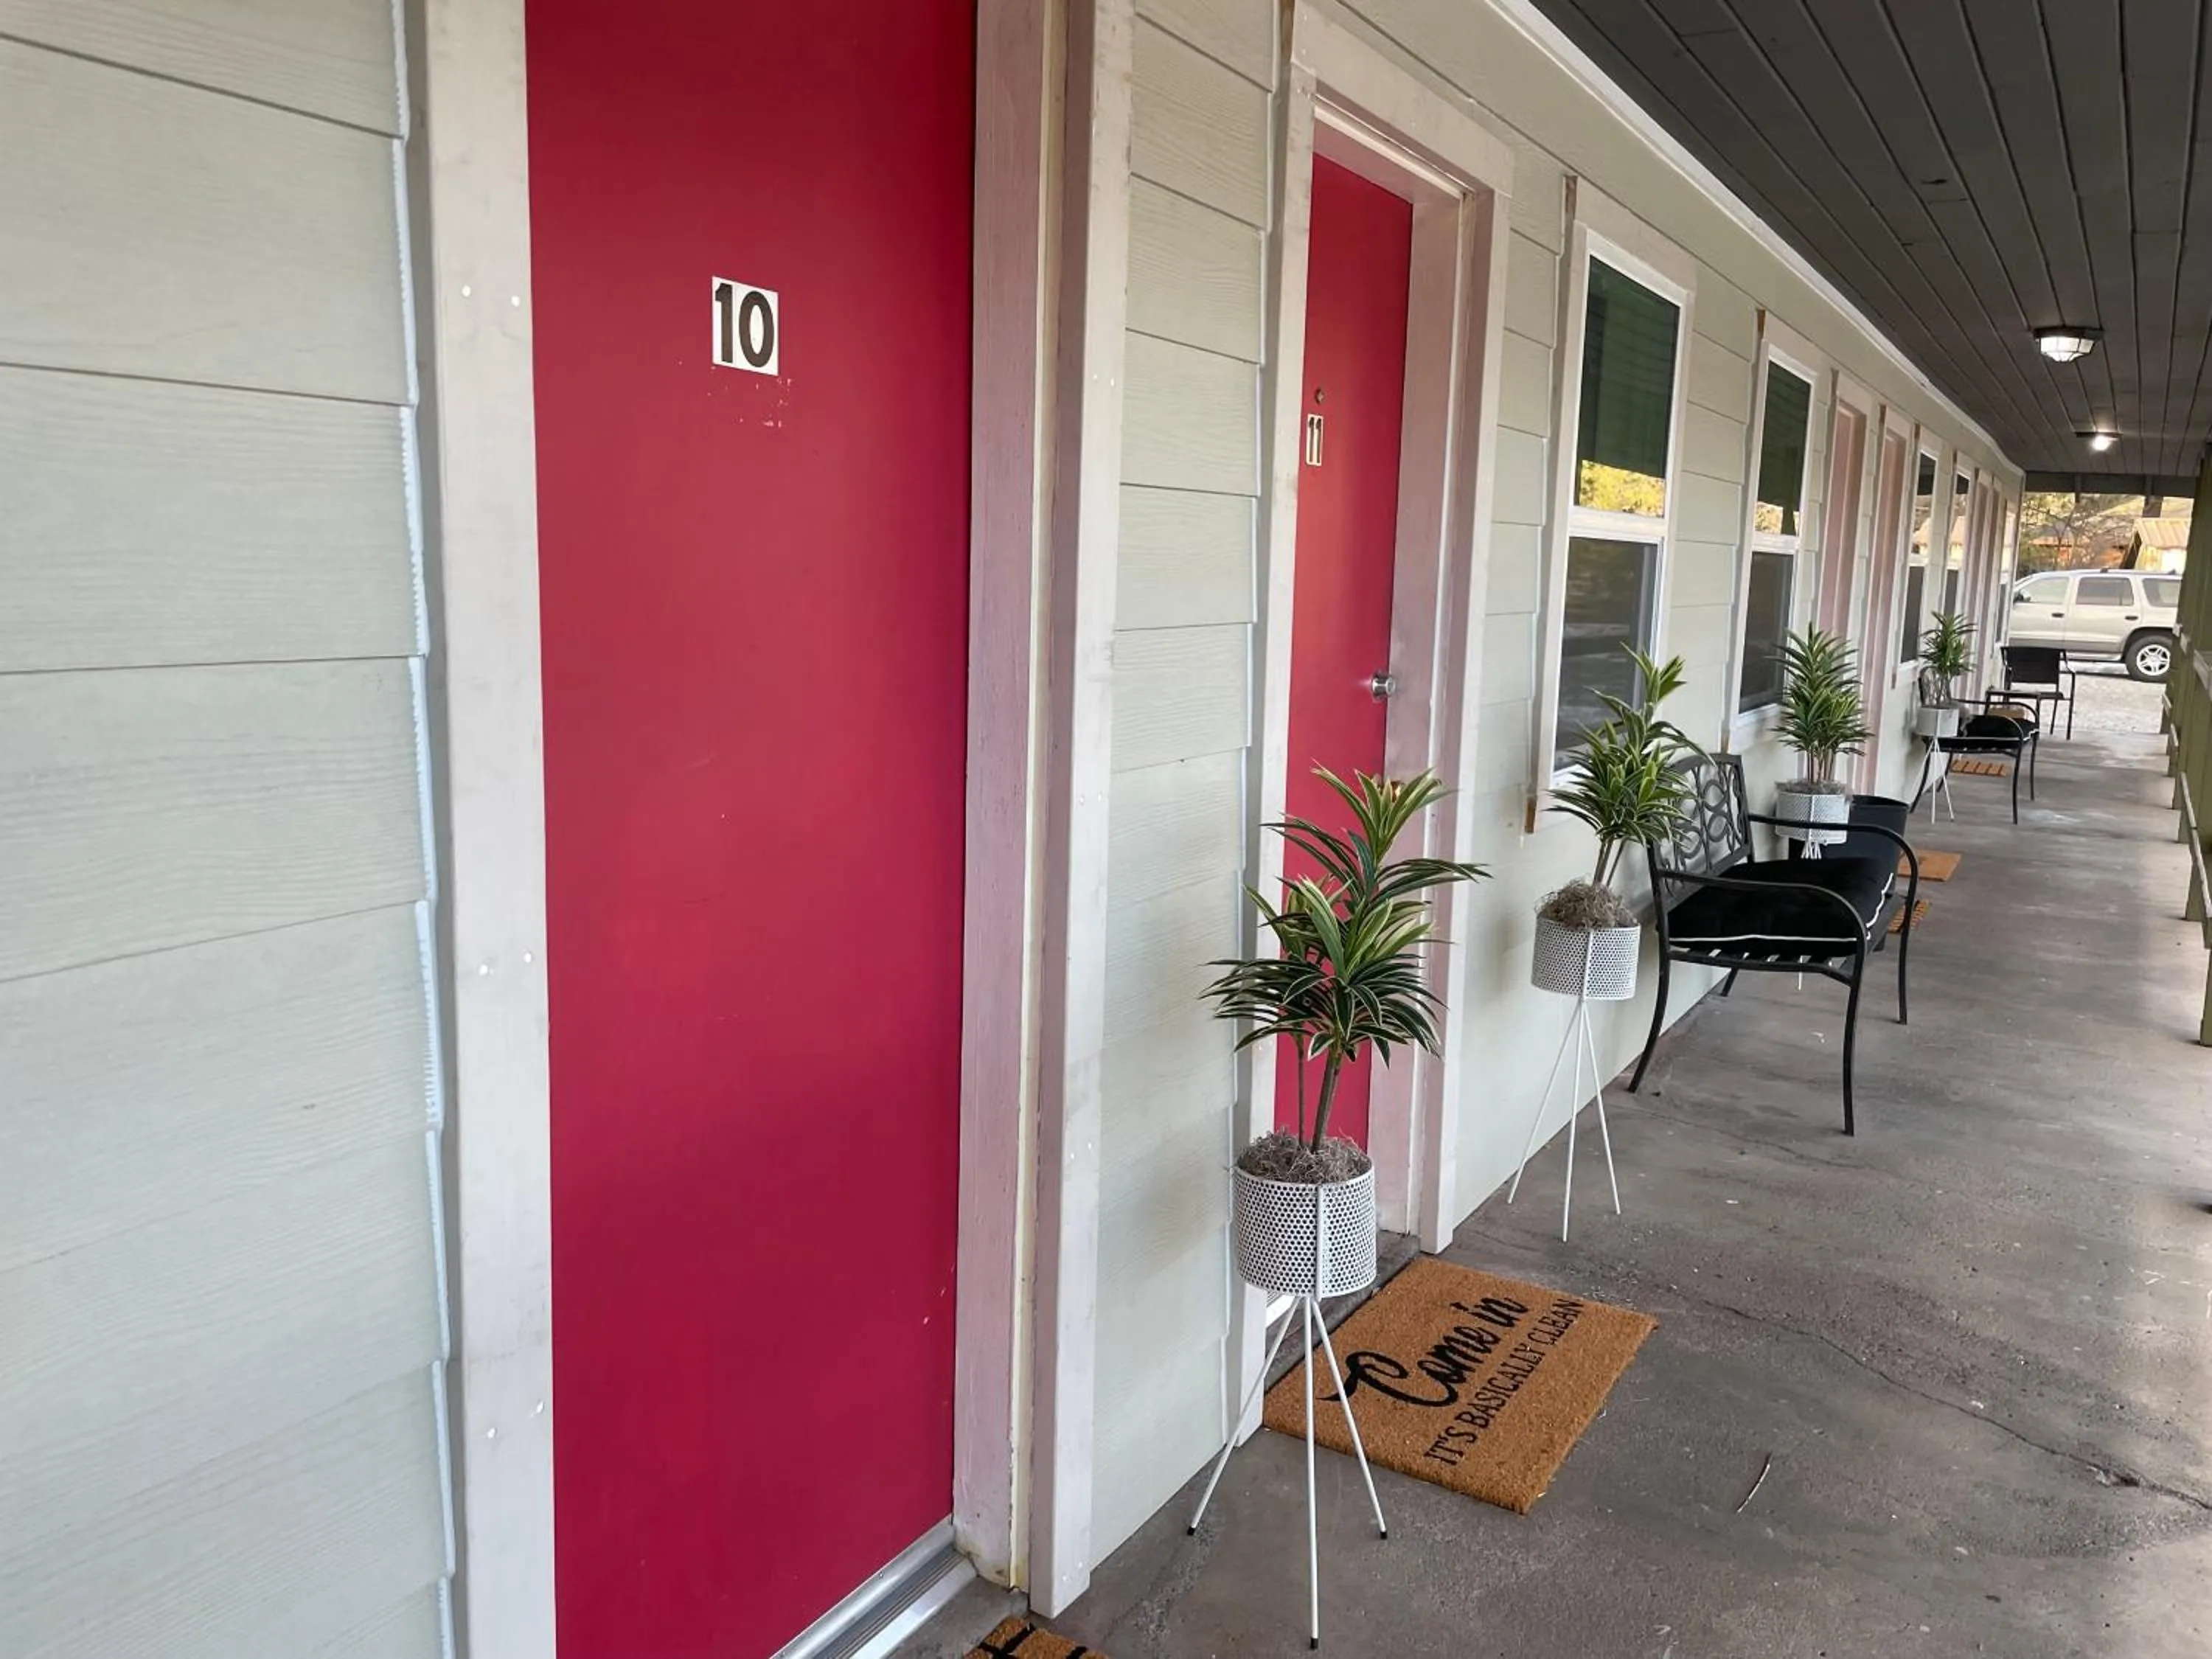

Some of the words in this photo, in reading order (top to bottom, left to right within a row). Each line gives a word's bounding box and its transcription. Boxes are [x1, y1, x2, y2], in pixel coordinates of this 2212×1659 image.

[715, 282, 774, 367] 10
[1309, 417, 1321, 464] 11
[1316, 1326, 1500, 1407] Come
[1450, 1297, 1528, 1327] in
[1424, 1426, 1477, 1465] IT'S
[1454, 1343, 1545, 1428] BASICALLY
[1528, 1298, 1584, 1346] CLEAN
